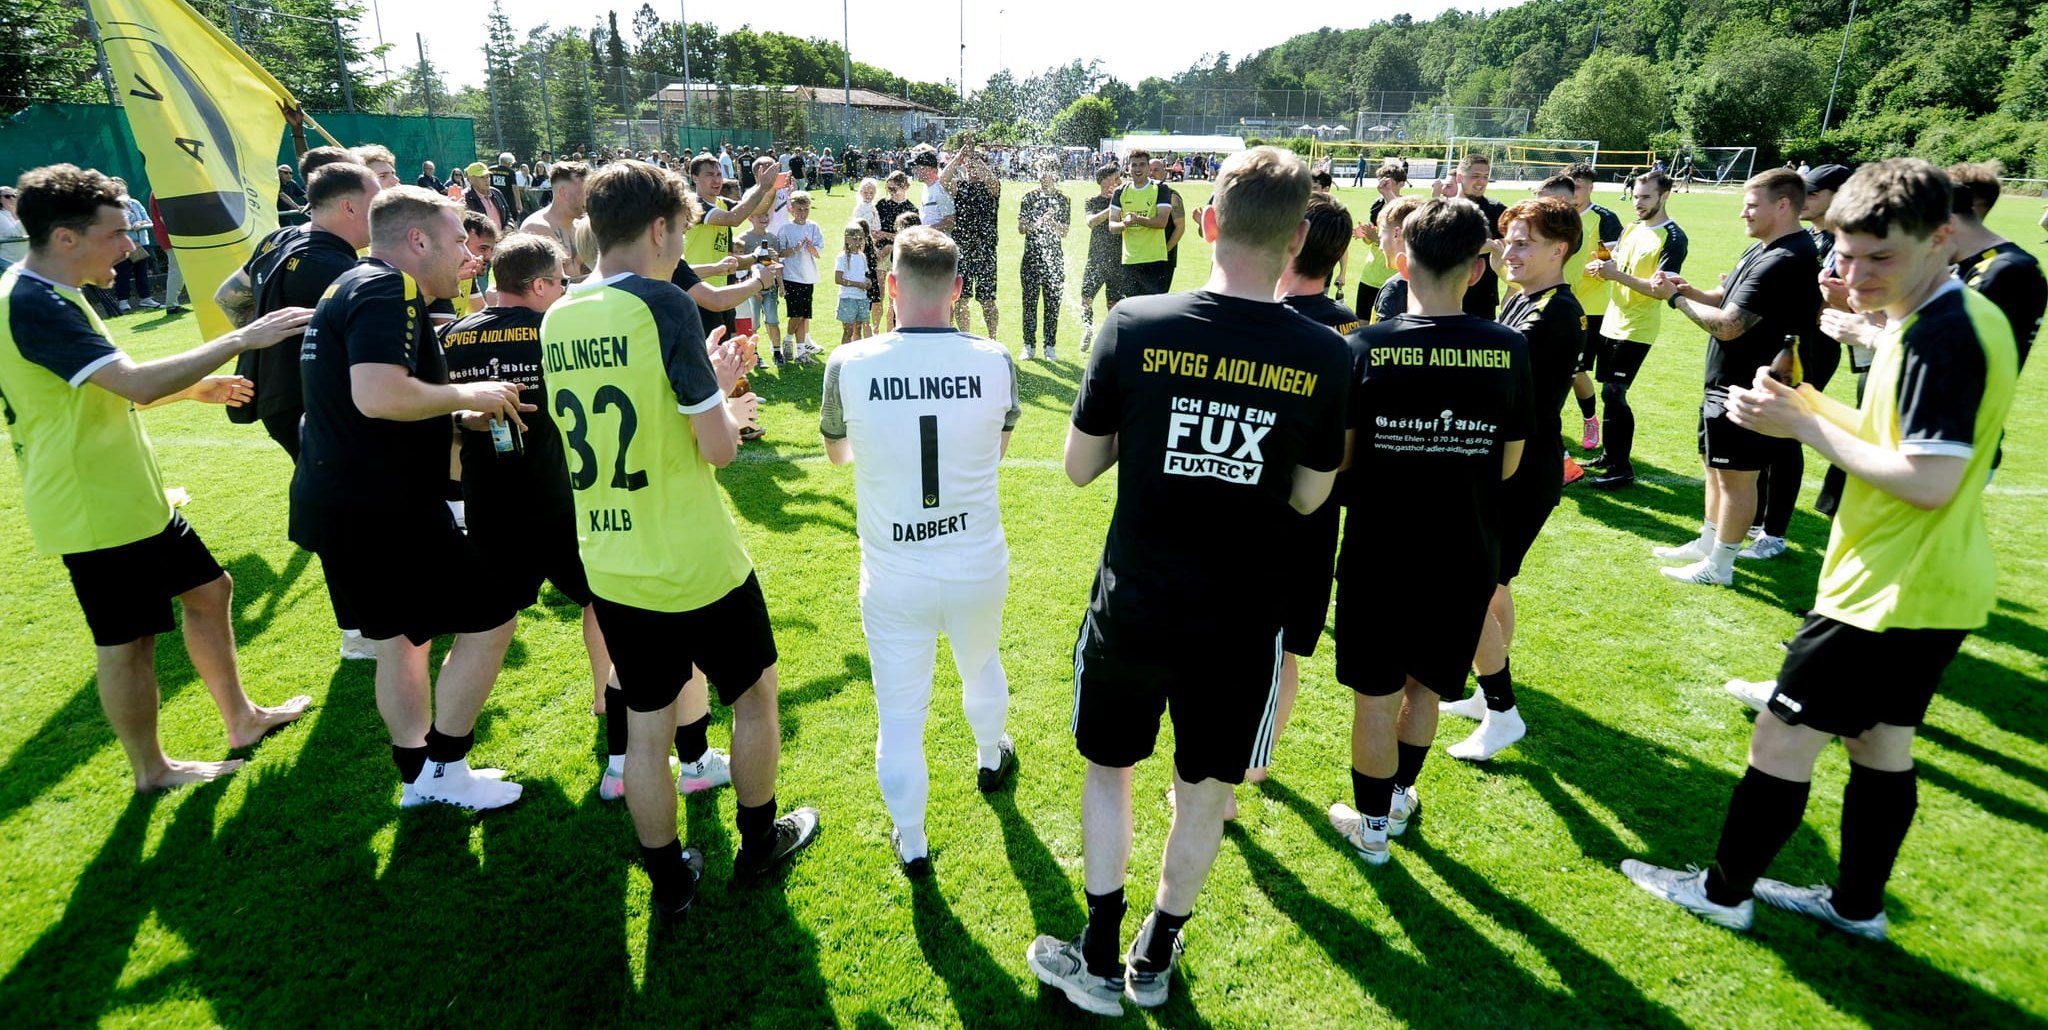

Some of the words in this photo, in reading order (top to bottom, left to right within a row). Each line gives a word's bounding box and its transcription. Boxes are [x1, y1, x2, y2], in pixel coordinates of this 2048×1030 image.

[129, 72, 164, 102] V
[174, 136, 205, 165] A
[443, 330, 478, 349] SPVGG
[480, 327, 538, 343] AIDLINGEN
[546, 335, 628, 373] IDLINGEN
[1370, 347, 1423, 366] SPVGG
[1429, 348, 1511, 369] AIDLINGEN
[449, 365, 490, 380] Gasthof
[501, 362, 538, 373] Adler
[1142, 348, 1209, 378] SPVGG
[1213, 357, 1318, 397] AIDLINGEN
[869, 375, 982, 401] AIDLINGEN
[1171, 396, 1203, 413] ICH
[1207, 401, 1240, 419] BIN
[1244, 407, 1277, 426] EIN
[1375, 415, 1439, 432] Gasthof
[1455, 419, 1497, 433] Adler
[555, 384, 649, 491] 32
[1166, 412, 1272, 462] FUX
[1374, 432, 1403, 441] Annette
[1404, 434, 1425, 442] Ehlen
[919, 415, 940, 509] 1
[1168, 456, 1241, 479] FUXTEC
[589, 508, 632, 532] KALB
[893, 512, 968, 542] DABBERT
